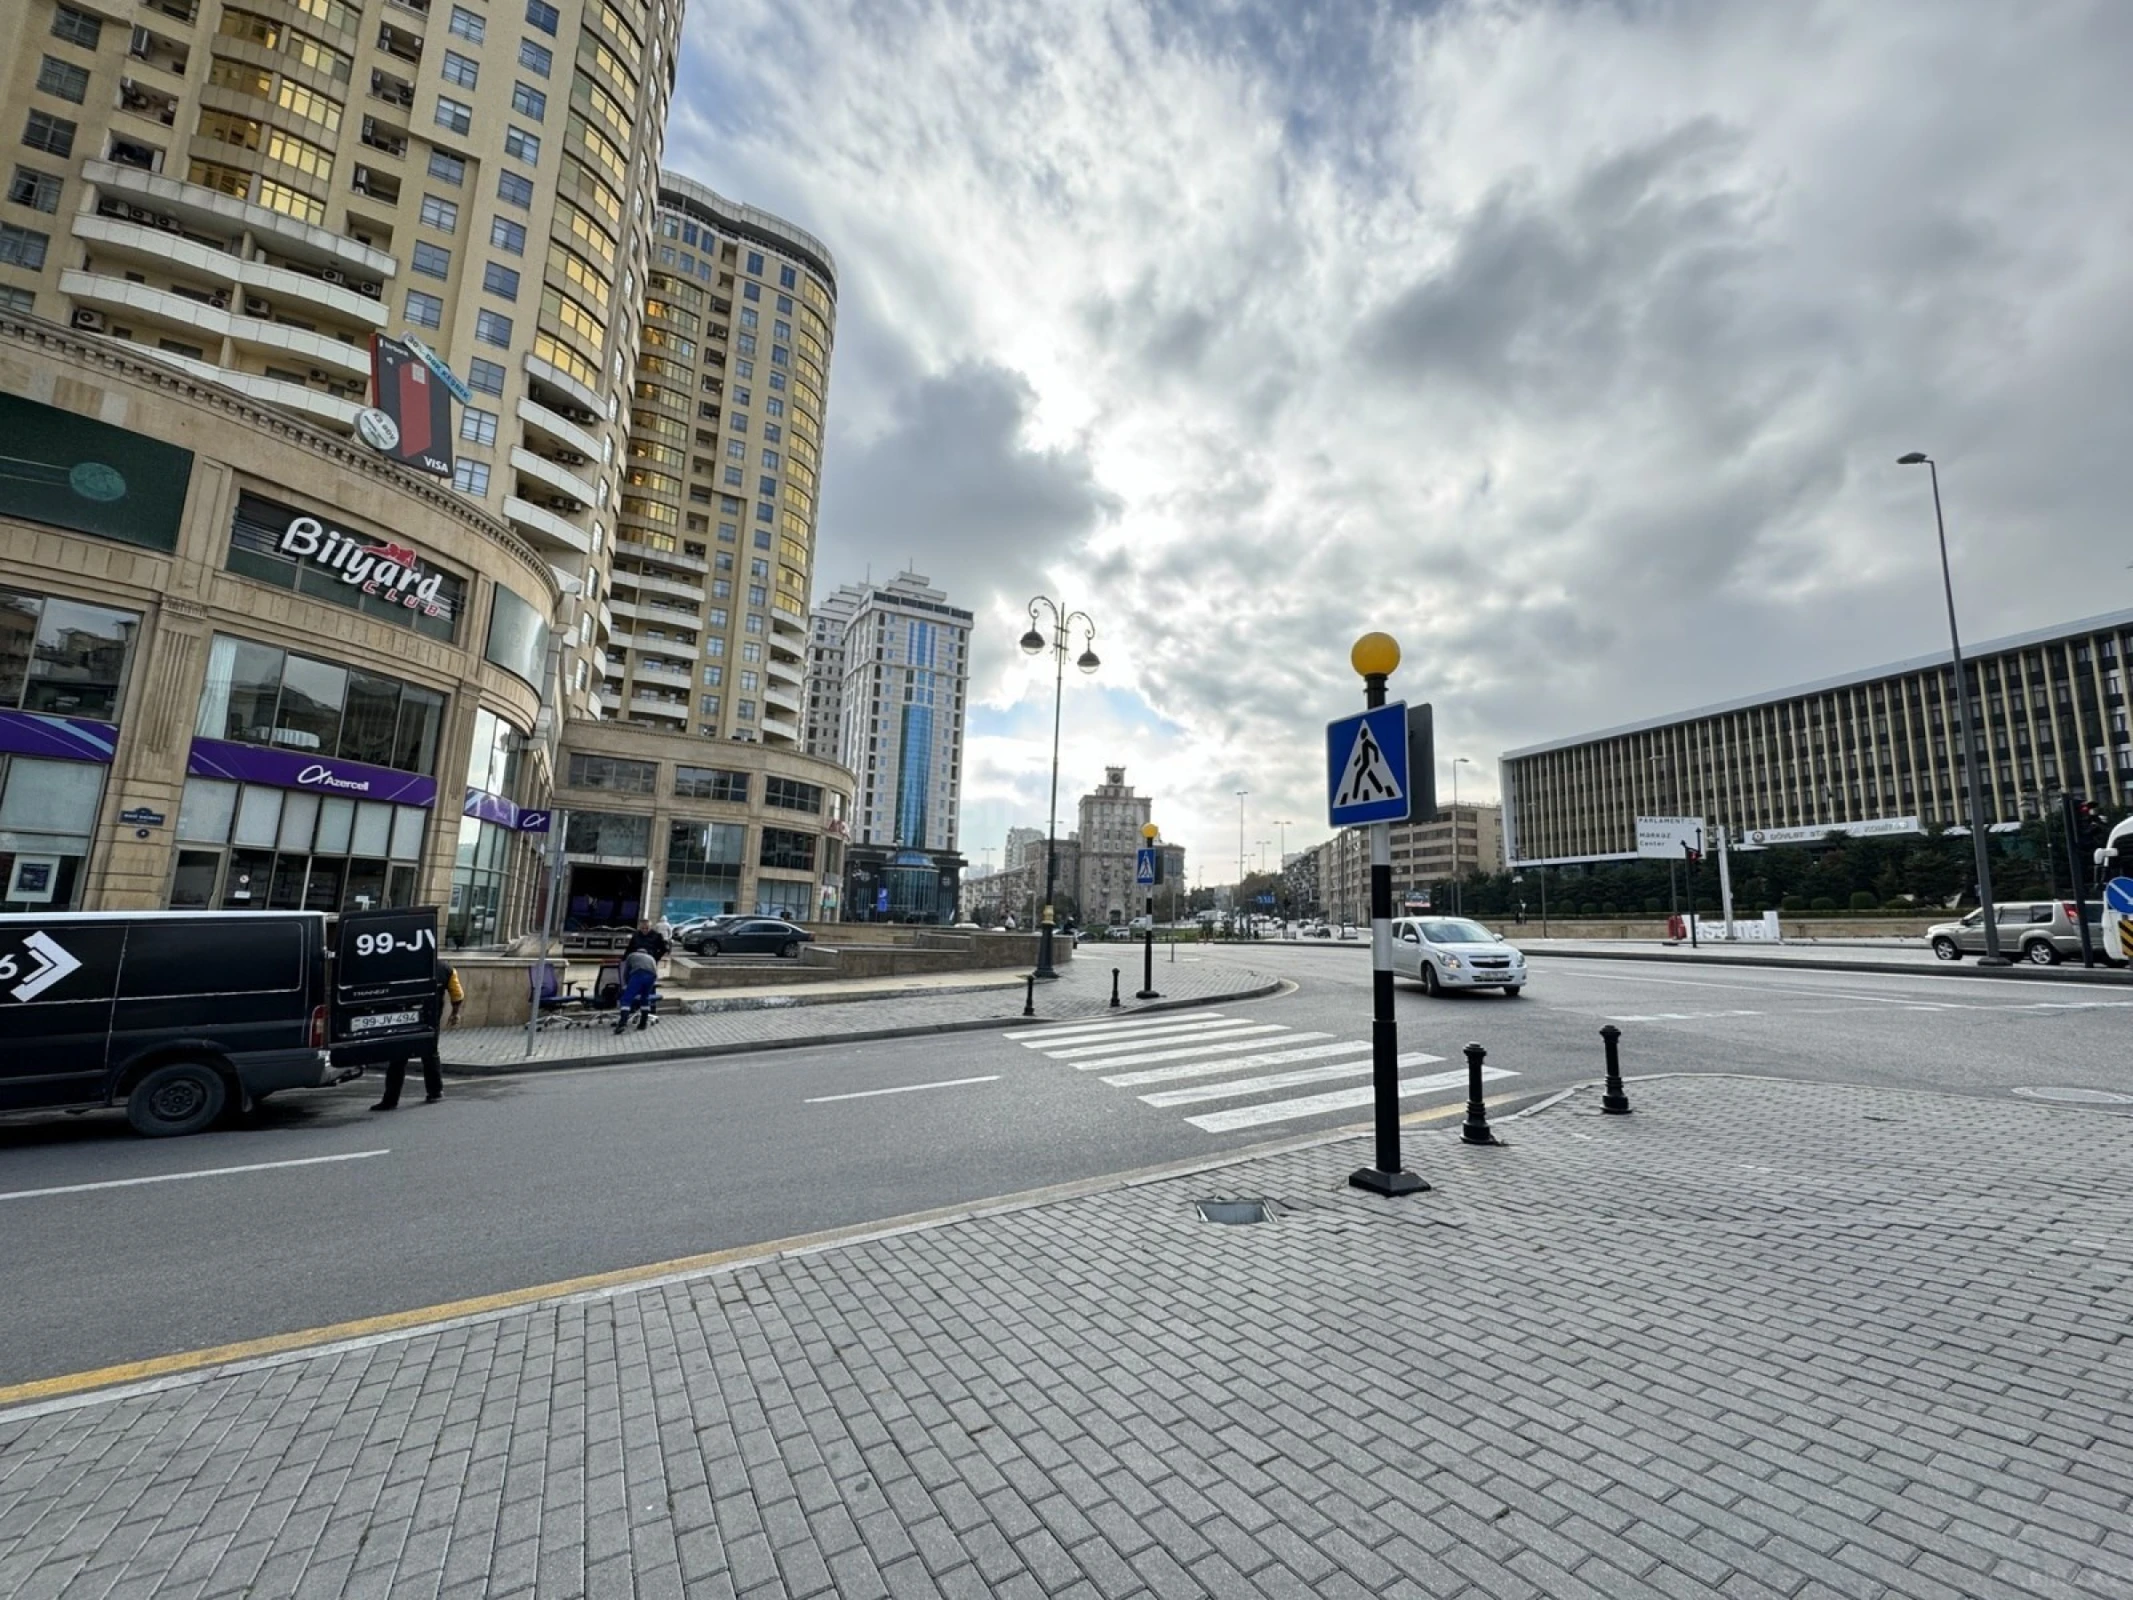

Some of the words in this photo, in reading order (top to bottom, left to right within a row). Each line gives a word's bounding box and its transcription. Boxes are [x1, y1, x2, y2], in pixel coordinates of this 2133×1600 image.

[423, 456, 448, 473] VISA
[362, 579, 441, 617] CLUB
[324, 775, 369, 792] Azercell
[1638, 817, 1685, 825] PARLAMENT
